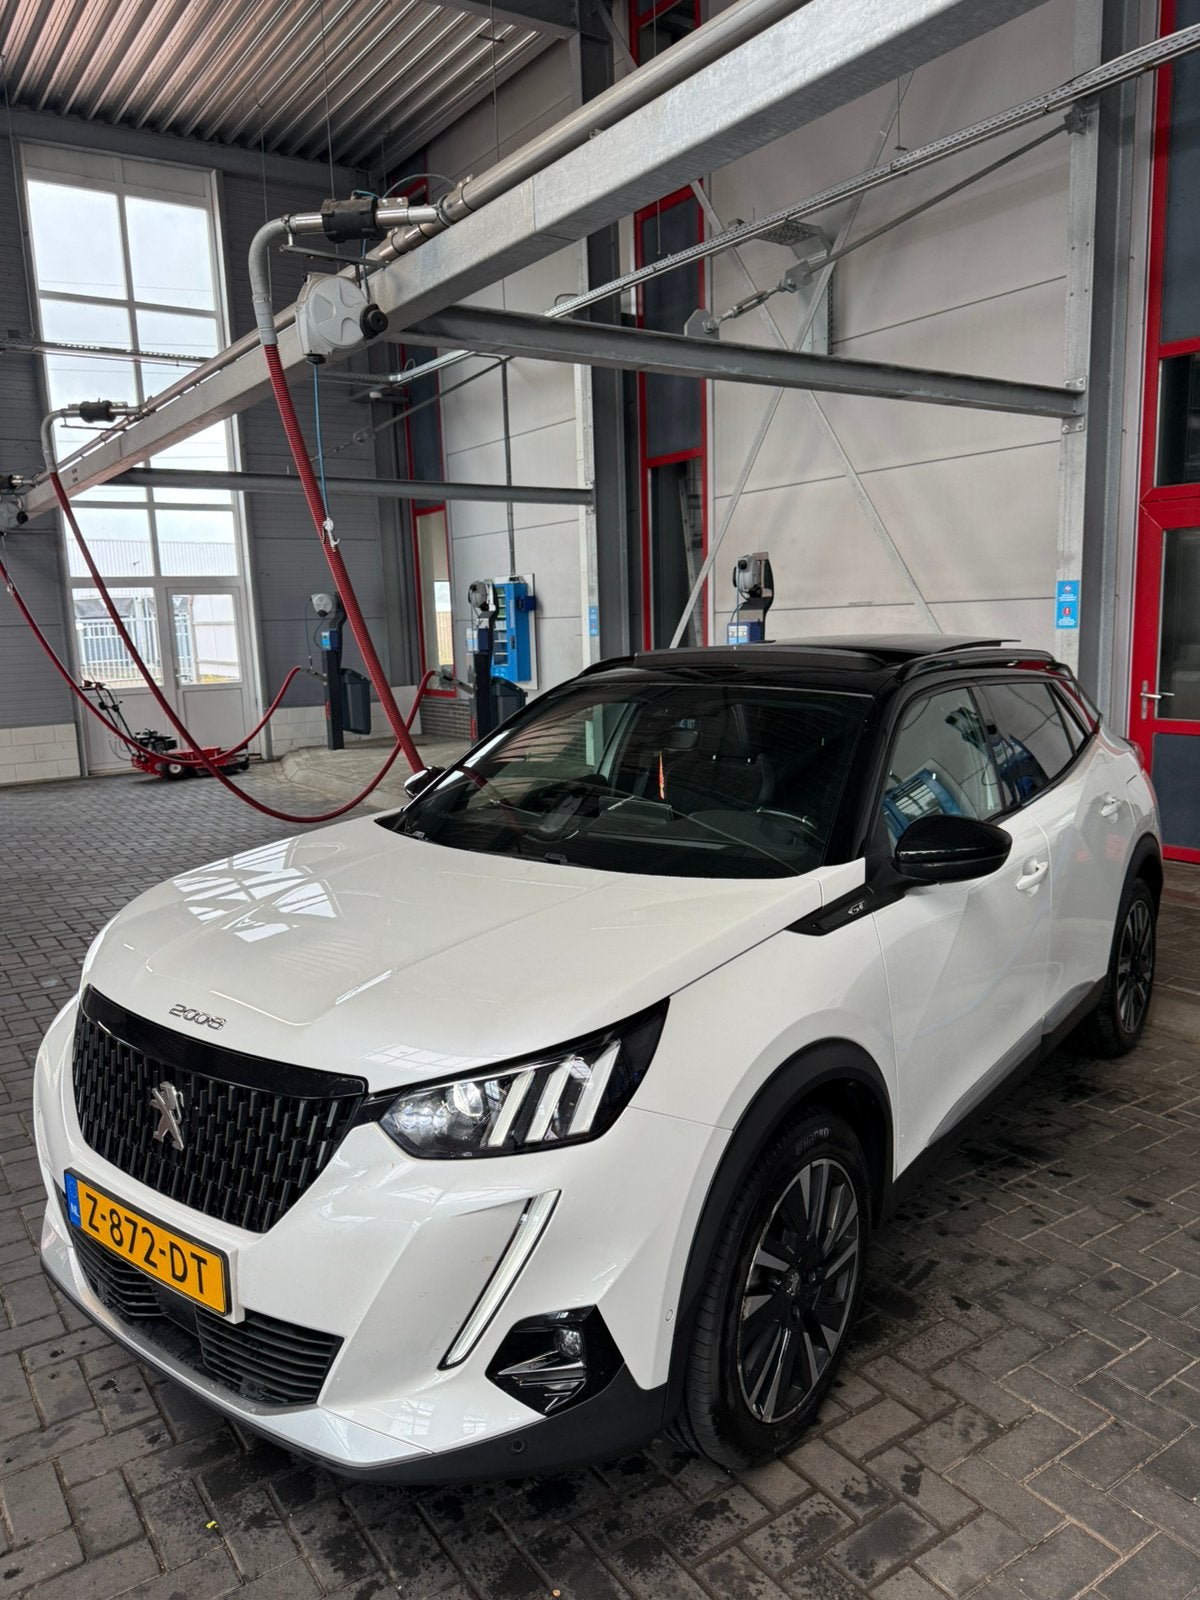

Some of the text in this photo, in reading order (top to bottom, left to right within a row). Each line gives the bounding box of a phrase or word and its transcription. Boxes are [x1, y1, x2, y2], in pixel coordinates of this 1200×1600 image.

[848, 901, 865, 915] GT
[169, 1004, 227, 1031] 2008
[70, 1203, 80, 1217] NL
[86, 1192, 208, 1295] Z-872-DT
